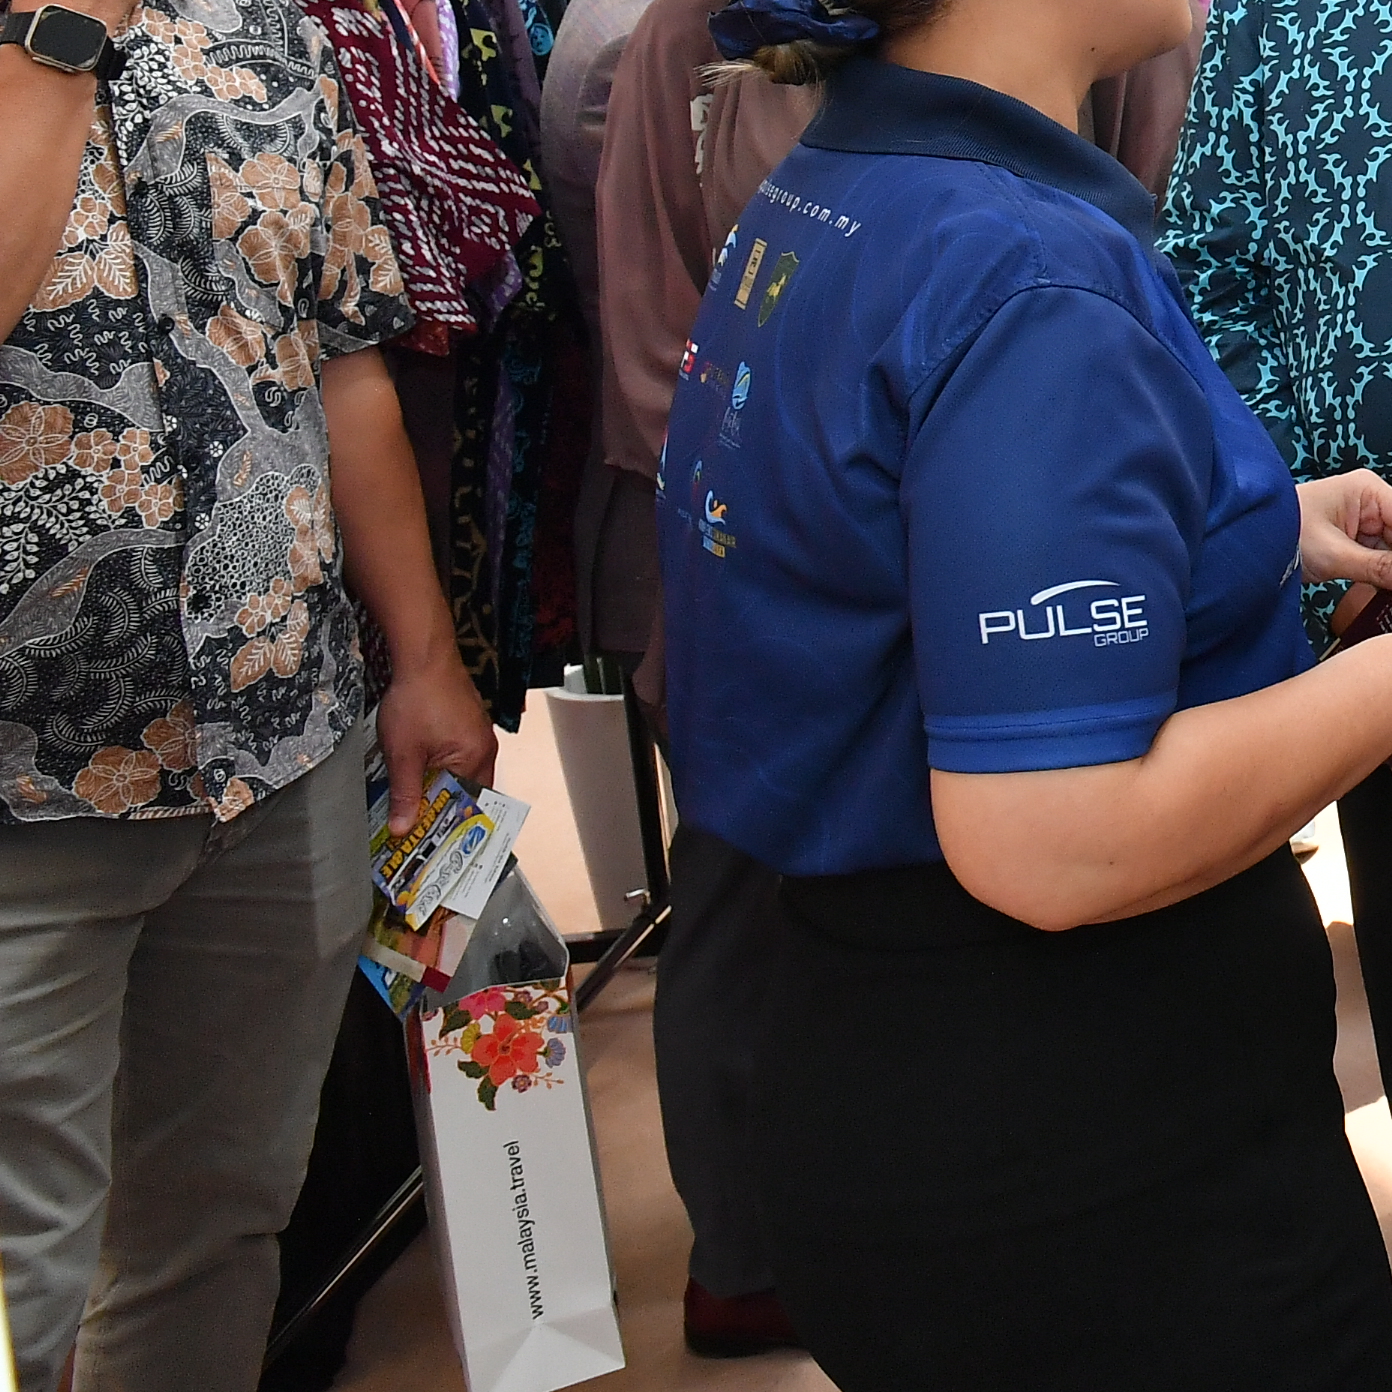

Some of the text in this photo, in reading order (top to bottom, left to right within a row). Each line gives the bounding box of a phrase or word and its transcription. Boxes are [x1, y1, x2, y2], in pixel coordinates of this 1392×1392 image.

[979, 595, 1148, 644] PULSE
[1094, 628, 1149, 647] GROUP
[503, 1140, 544, 1320] www.malaysia.travel
